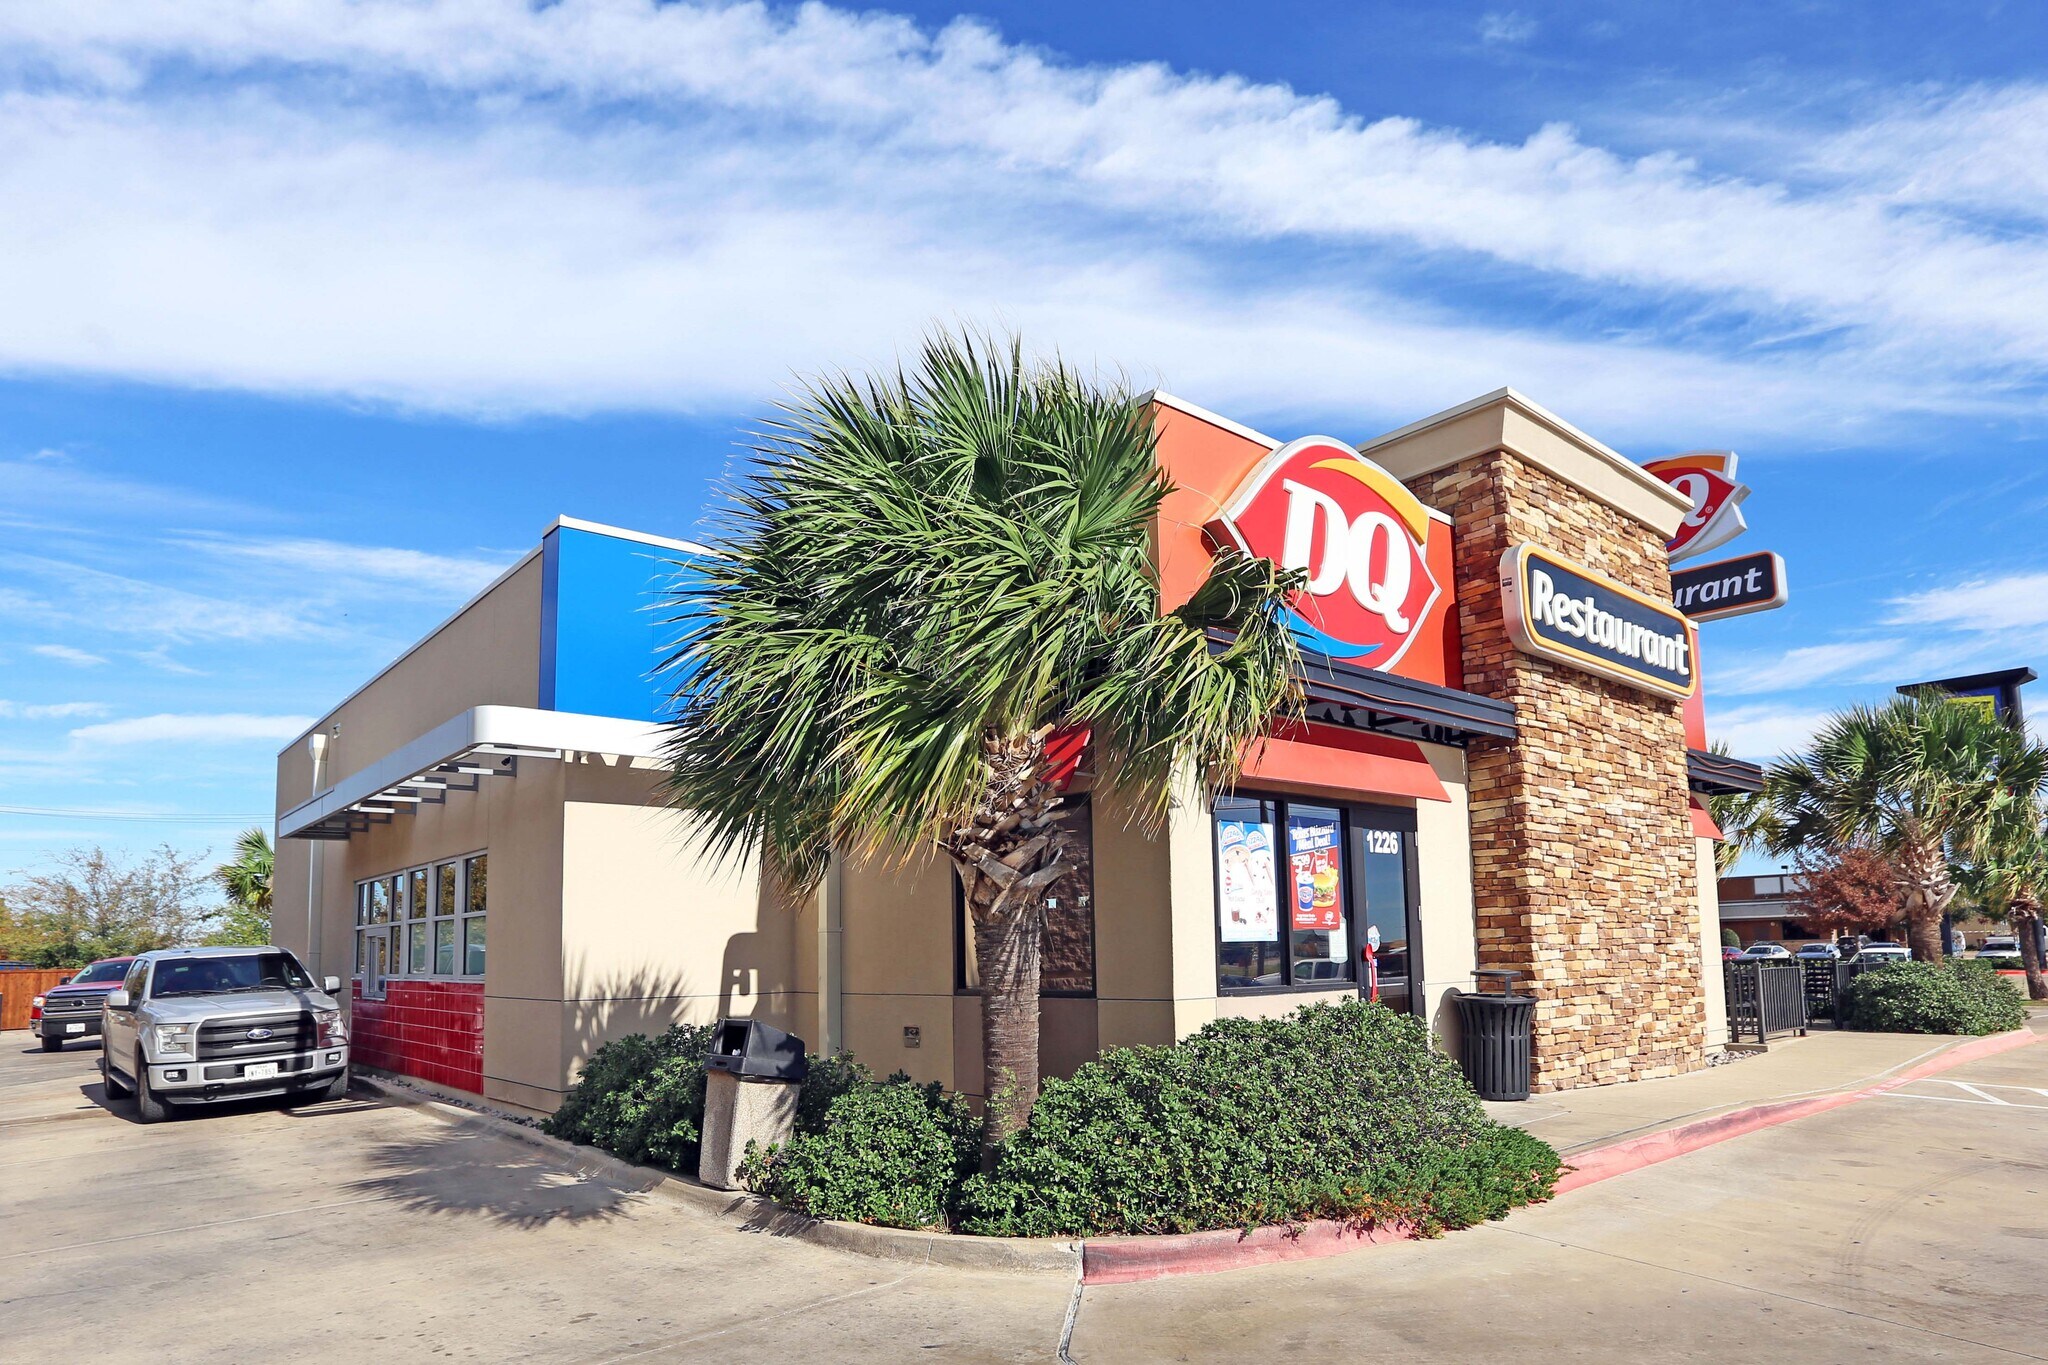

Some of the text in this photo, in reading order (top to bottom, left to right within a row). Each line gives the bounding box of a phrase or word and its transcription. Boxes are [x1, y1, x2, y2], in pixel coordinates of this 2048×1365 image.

[1282, 478, 1411, 634] DQ
[1532, 569, 1690, 676] Restaurant
[1366, 830, 1399, 854] 1226
